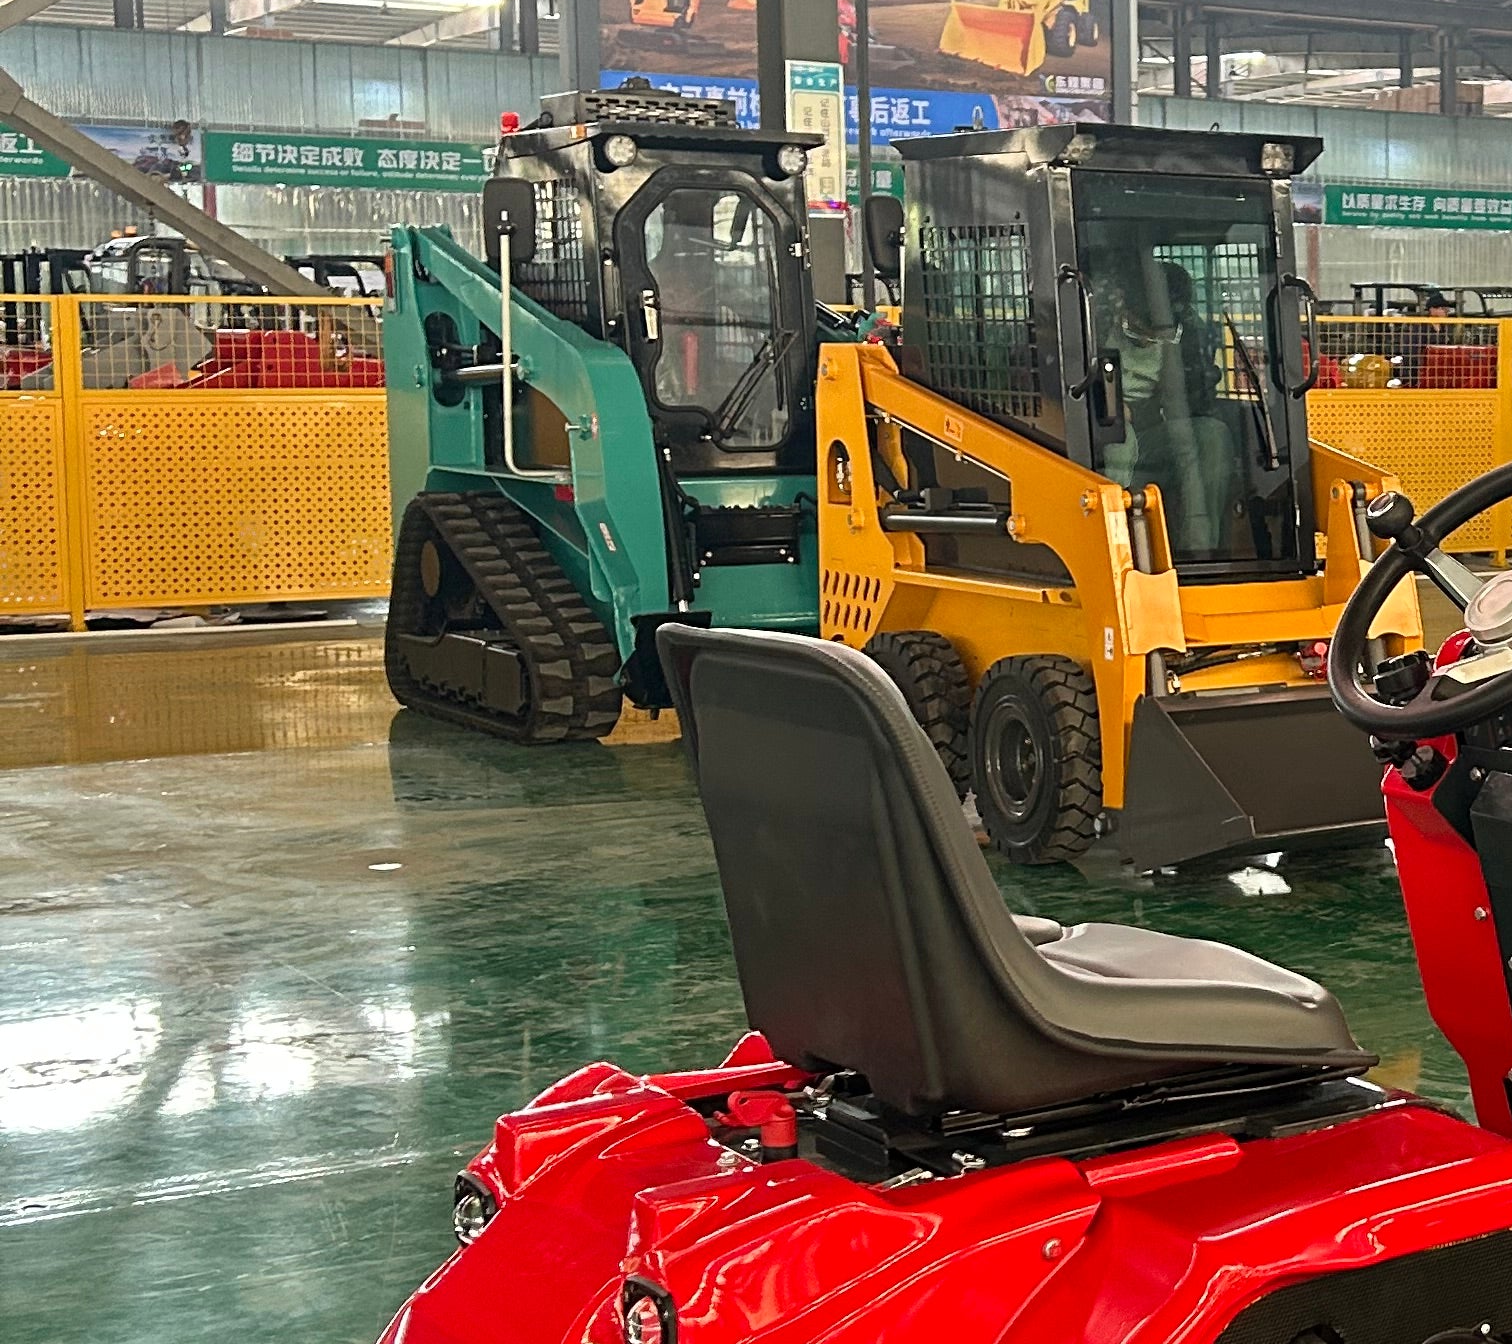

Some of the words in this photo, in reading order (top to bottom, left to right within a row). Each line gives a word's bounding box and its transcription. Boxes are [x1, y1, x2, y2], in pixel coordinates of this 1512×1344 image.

[231, 142, 363, 167] 细节决定成败
